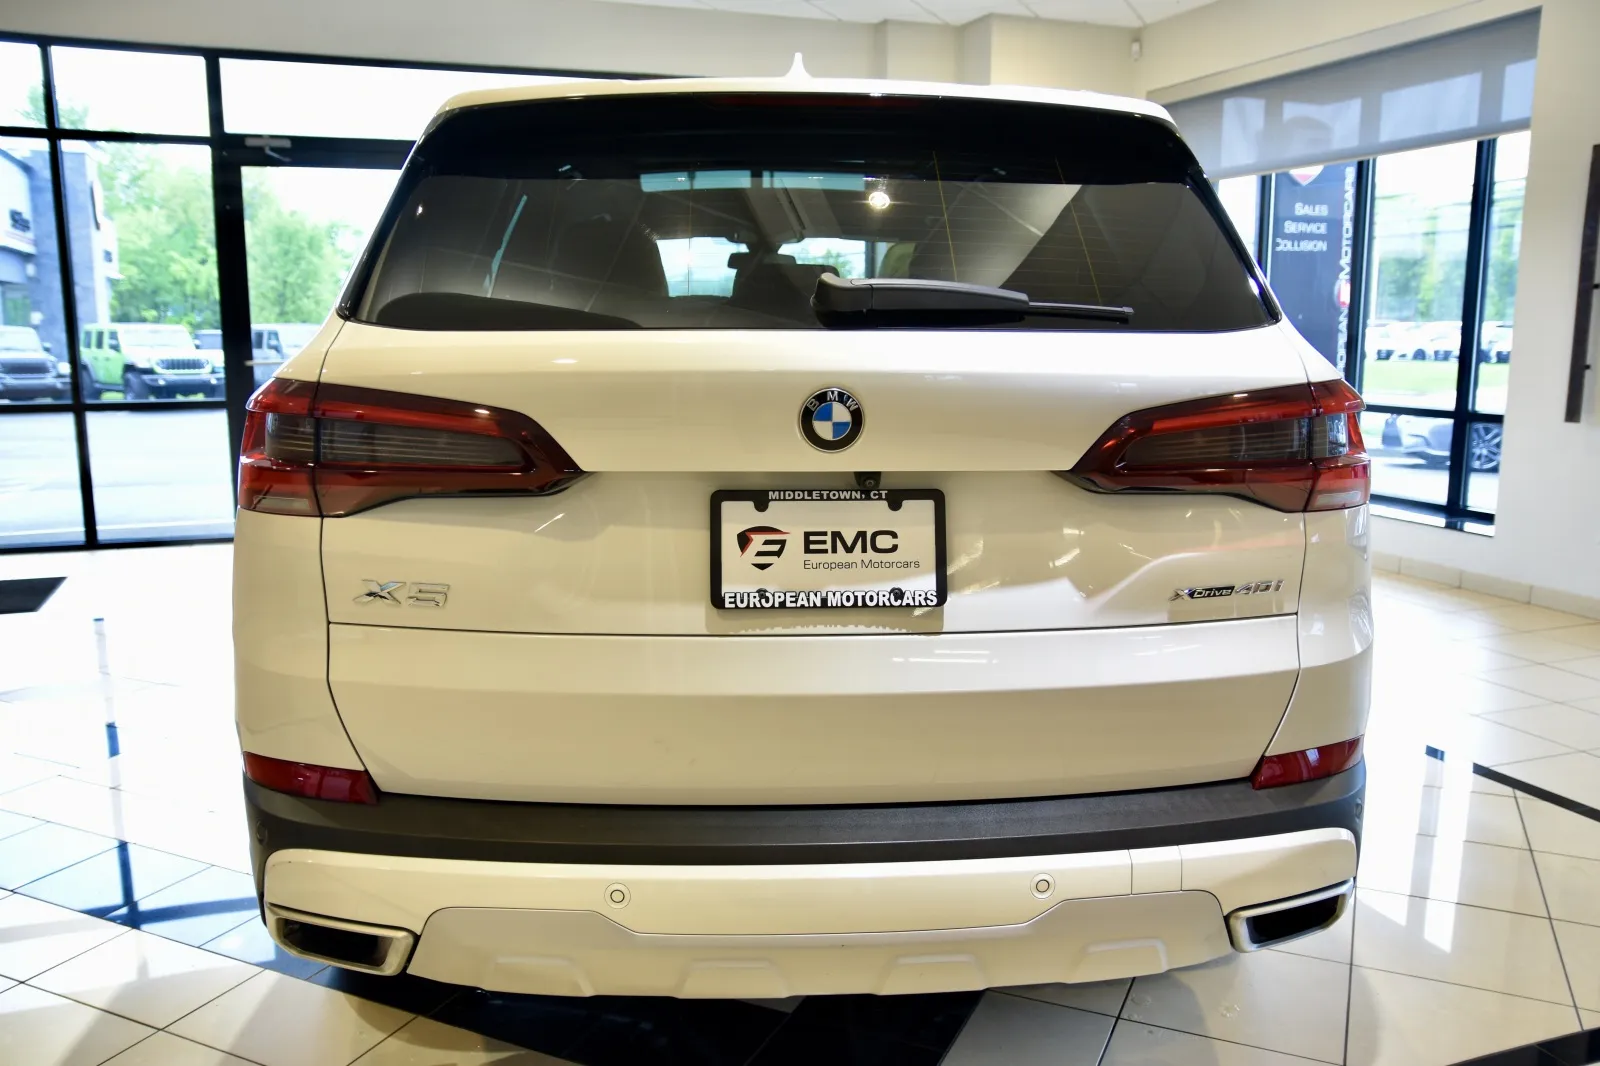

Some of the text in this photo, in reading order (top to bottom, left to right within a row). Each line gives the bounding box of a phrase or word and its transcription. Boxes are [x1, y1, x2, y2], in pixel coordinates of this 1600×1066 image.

[1294, 202, 1328, 216] SALES
[1284, 220, 1328, 234] SERVICE
[1339, 166, 1356, 280] MOTORCARS
[806, 390, 859, 412] BMW
[768, 490, 888, 500] MIDDLETOWN, CT
[803, 530, 899, 554] EMC
[803, 559, 920, 571] European Motorcars
[352, 579, 450, 608] X5
[1235, 580, 1284, 595] 40i
[724, 590, 938, 608] EUROPEAN MOTORCARS
